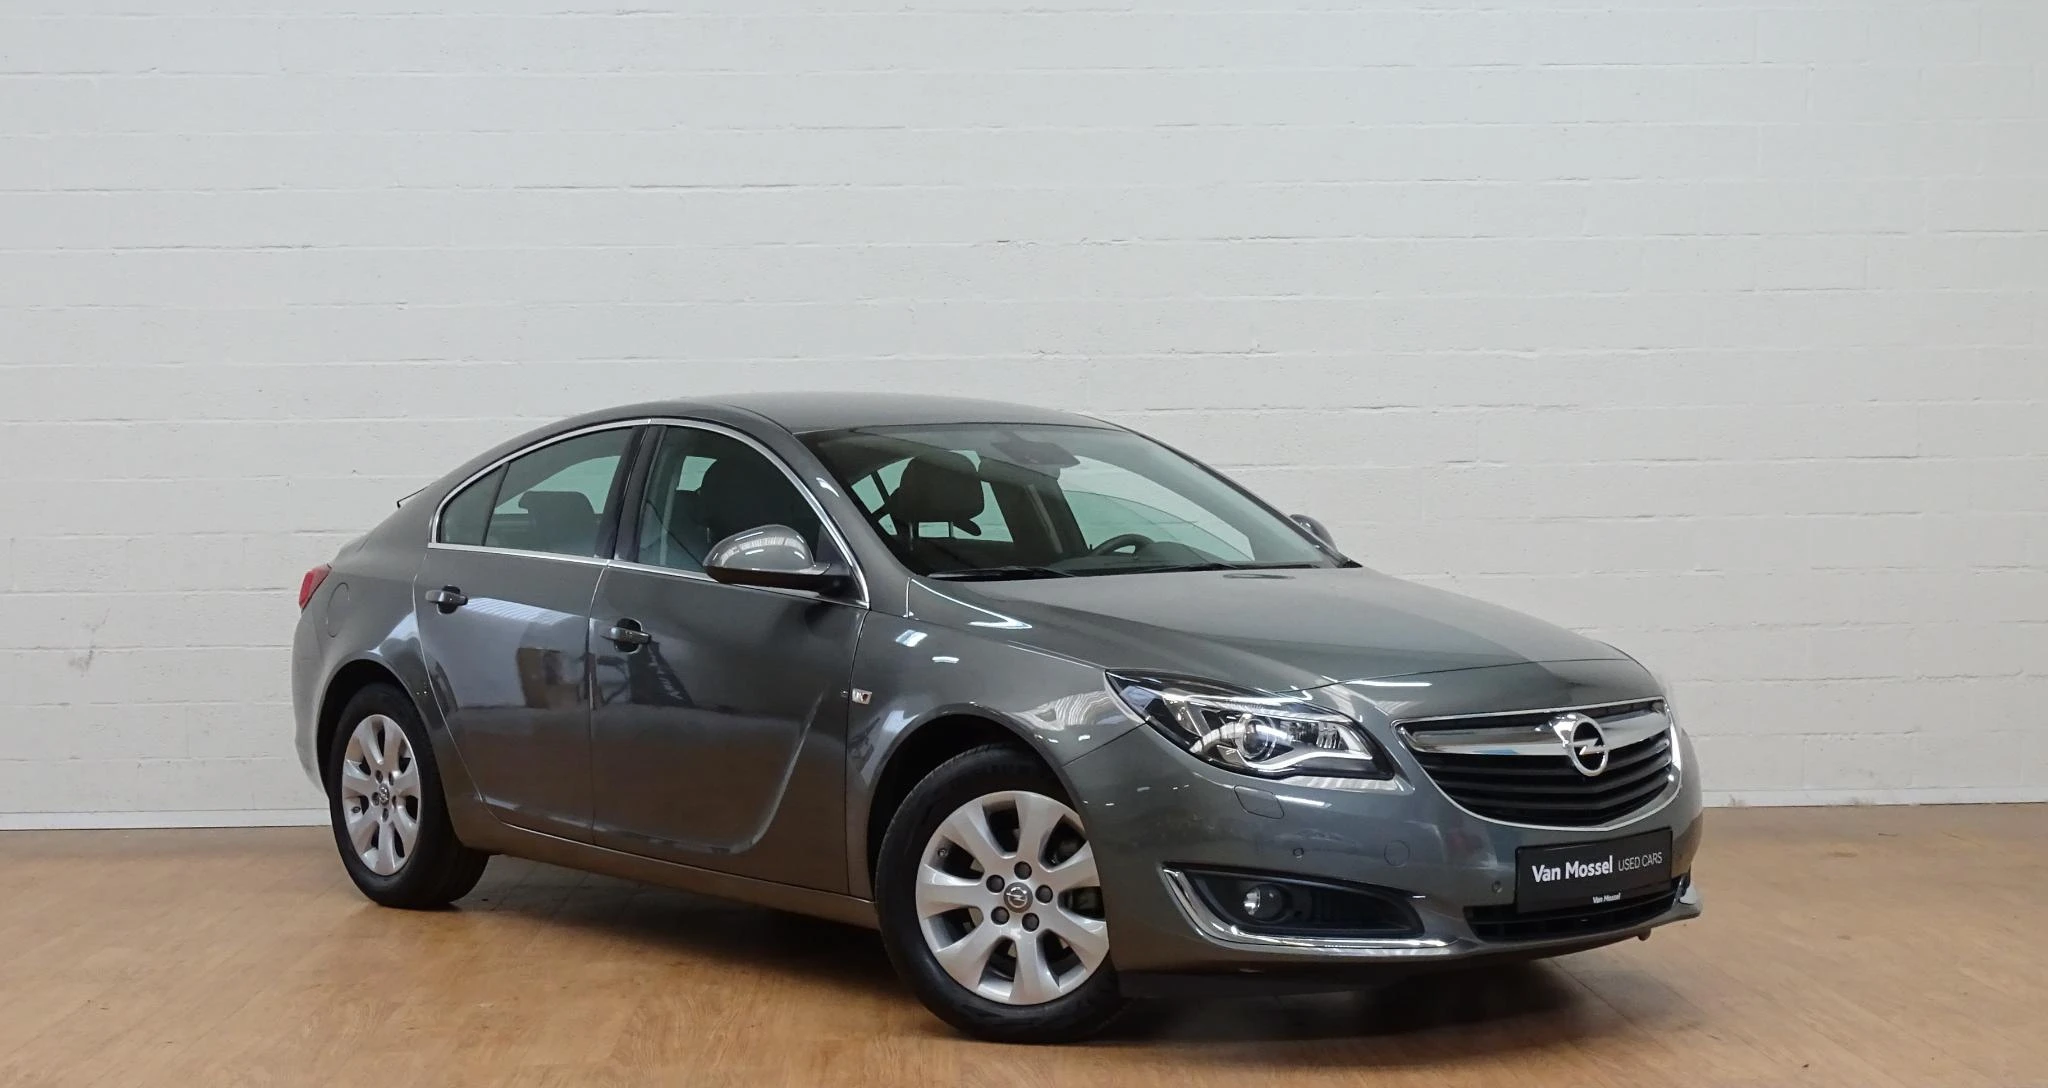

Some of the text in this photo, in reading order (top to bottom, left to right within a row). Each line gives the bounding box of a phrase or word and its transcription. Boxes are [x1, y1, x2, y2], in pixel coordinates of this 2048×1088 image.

[1532, 852, 1663, 882] Van Mossel USED CARS
[1592, 896, 1603, 904] Van
